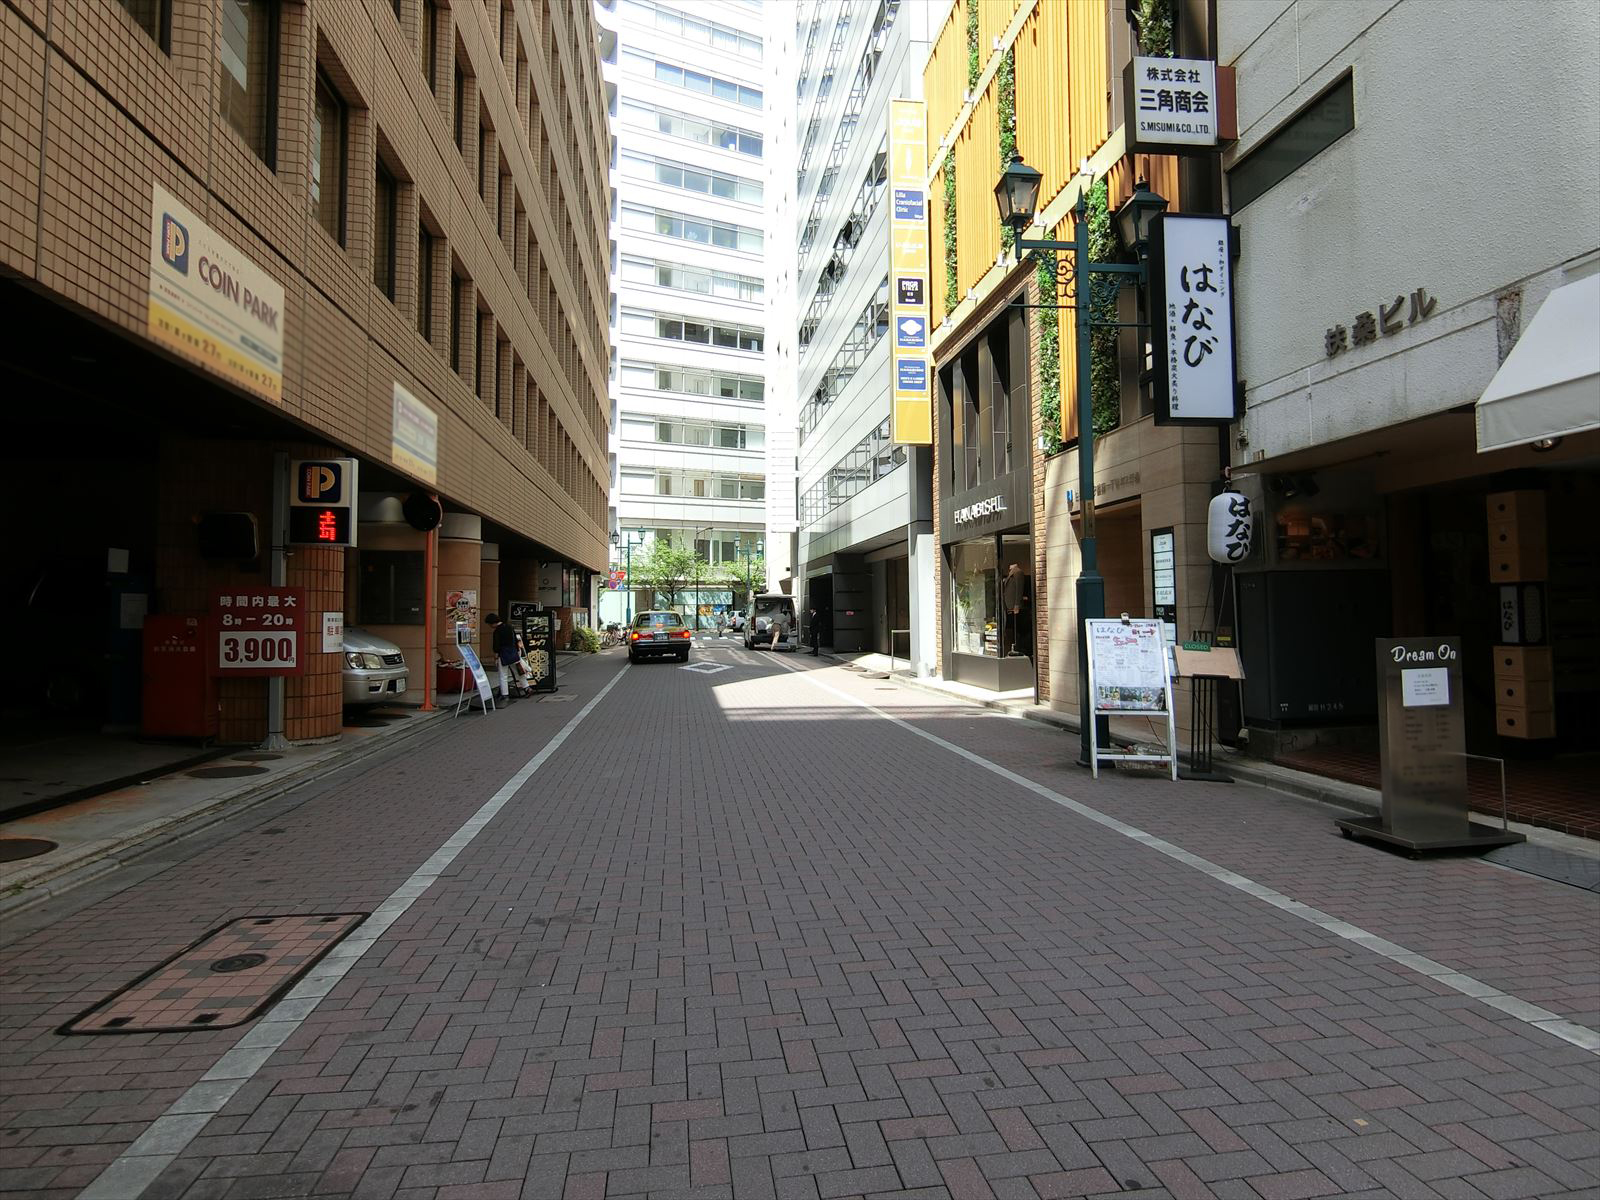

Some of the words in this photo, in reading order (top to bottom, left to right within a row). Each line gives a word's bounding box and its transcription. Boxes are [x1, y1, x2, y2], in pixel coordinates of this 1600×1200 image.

[1146, 67, 1200, 84] 株式会社
[1140, 89, 1209, 114] 三角商会
[199, 256, 239, 307] COIN
[244, 287, 279, 334] PARK
[1181, 263, 1218, 368] はなび
[1325, 288, 1437, 357] 扶桑ビル
[954, 496, 1003, 525] HANABISHI
[1225, 497, 1251, 561] はなび
[220, 595, 297, 607] 時間内最大
[1391, 646, 1435, 662] Dream
[1438, 644, 1456, 660] On
